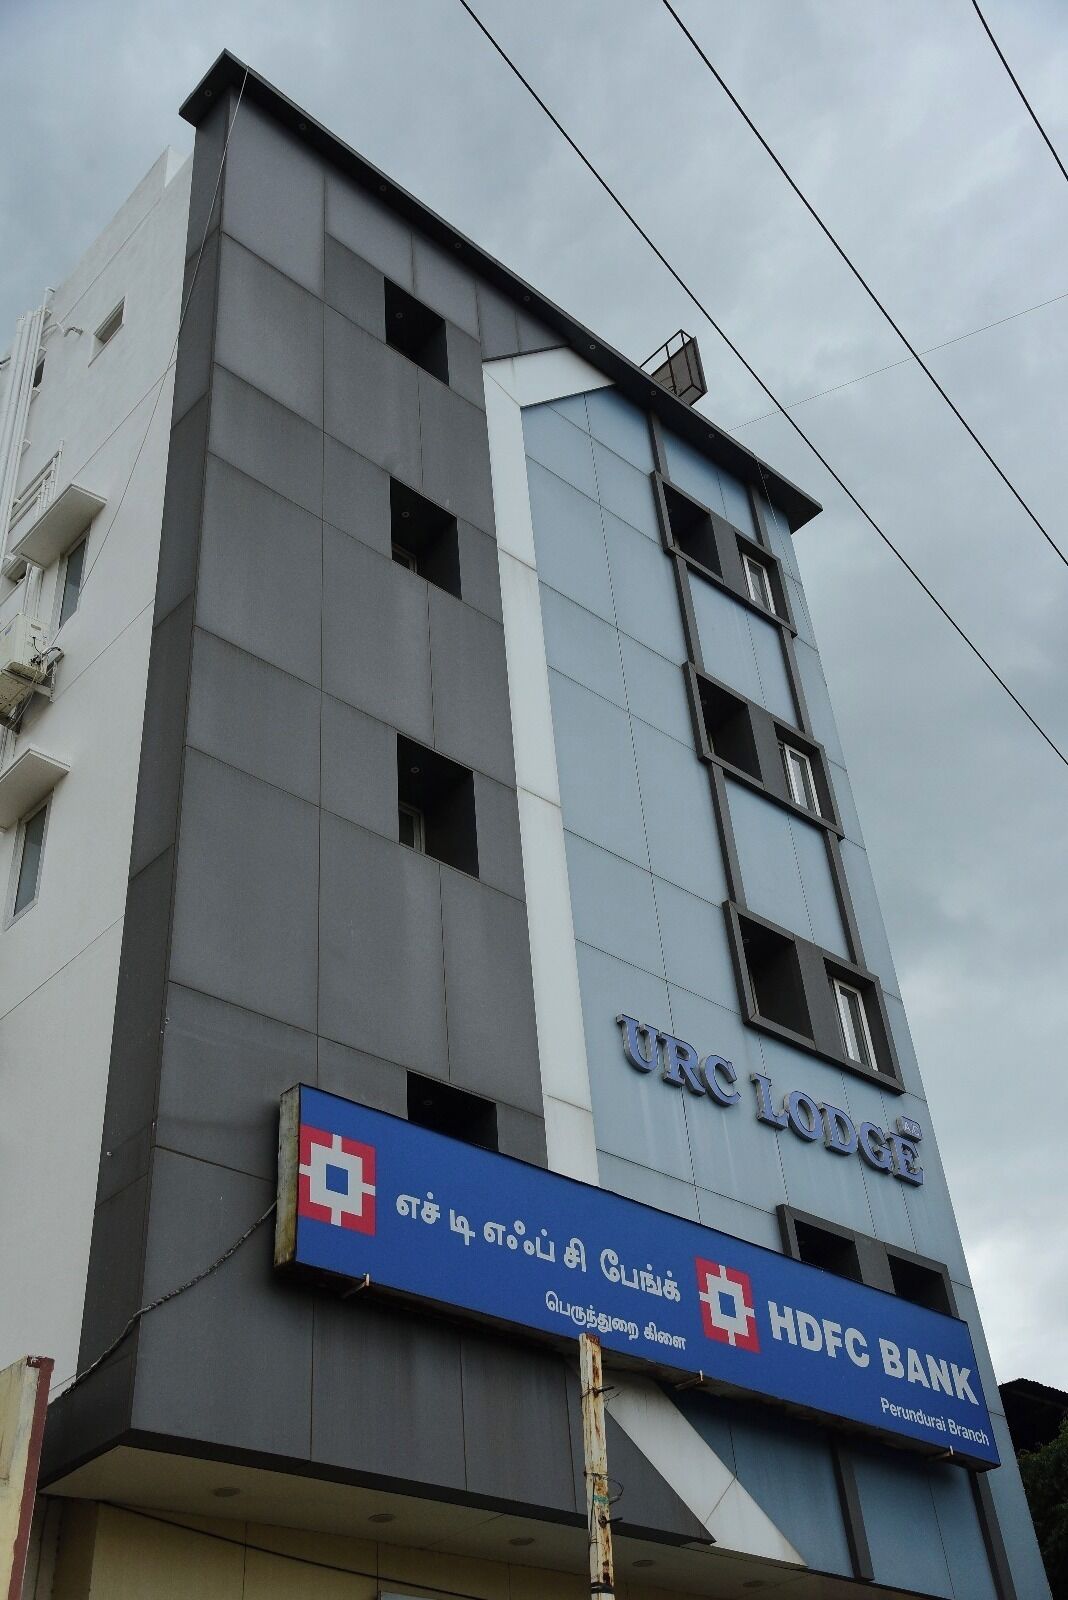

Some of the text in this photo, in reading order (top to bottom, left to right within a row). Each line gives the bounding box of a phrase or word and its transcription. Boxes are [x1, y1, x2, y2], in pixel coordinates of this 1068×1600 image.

[615, 1012, 924, 1188] URC LODGE
[396, 1192, 681, 1303] எச் டி எஃப் சி பேங்க்
[545, 1290, 687, 1351] பெருந்துறை கிளை
[767, 1300, 980, 1406] HDFC BANK
[880, 1396, 990, 1447] Perundurai Branch
